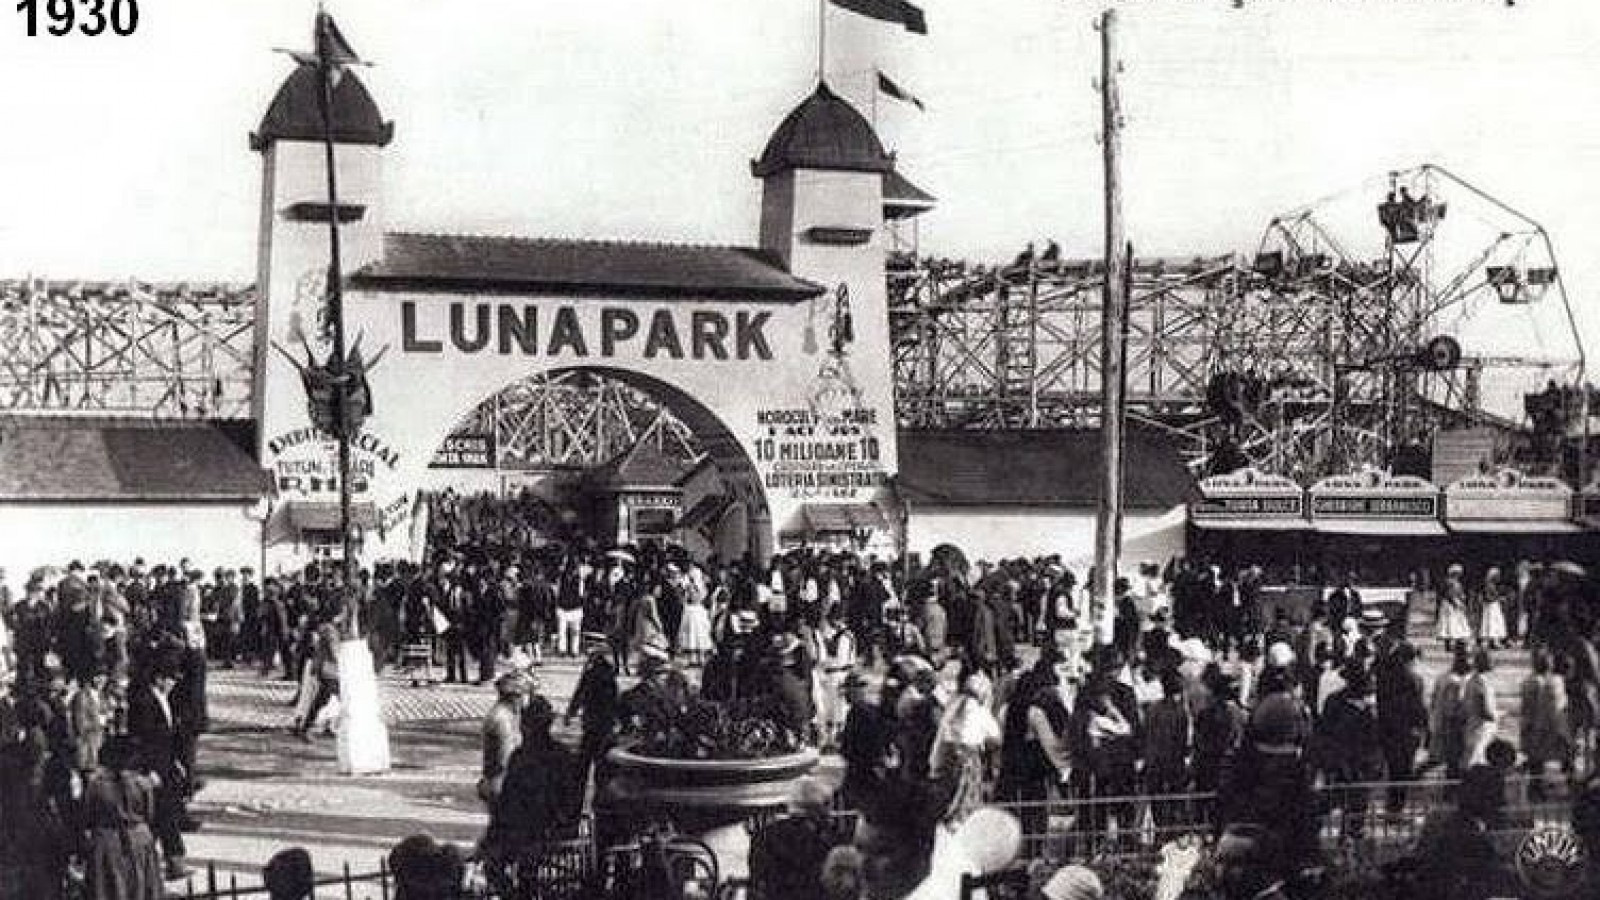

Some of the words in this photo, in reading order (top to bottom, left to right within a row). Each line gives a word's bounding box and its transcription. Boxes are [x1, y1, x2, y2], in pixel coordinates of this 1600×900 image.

[754, 438, 775, 460] 10
[780, 442, 858, 460] MILIOANE
[859, 437, 880, 460] 10
